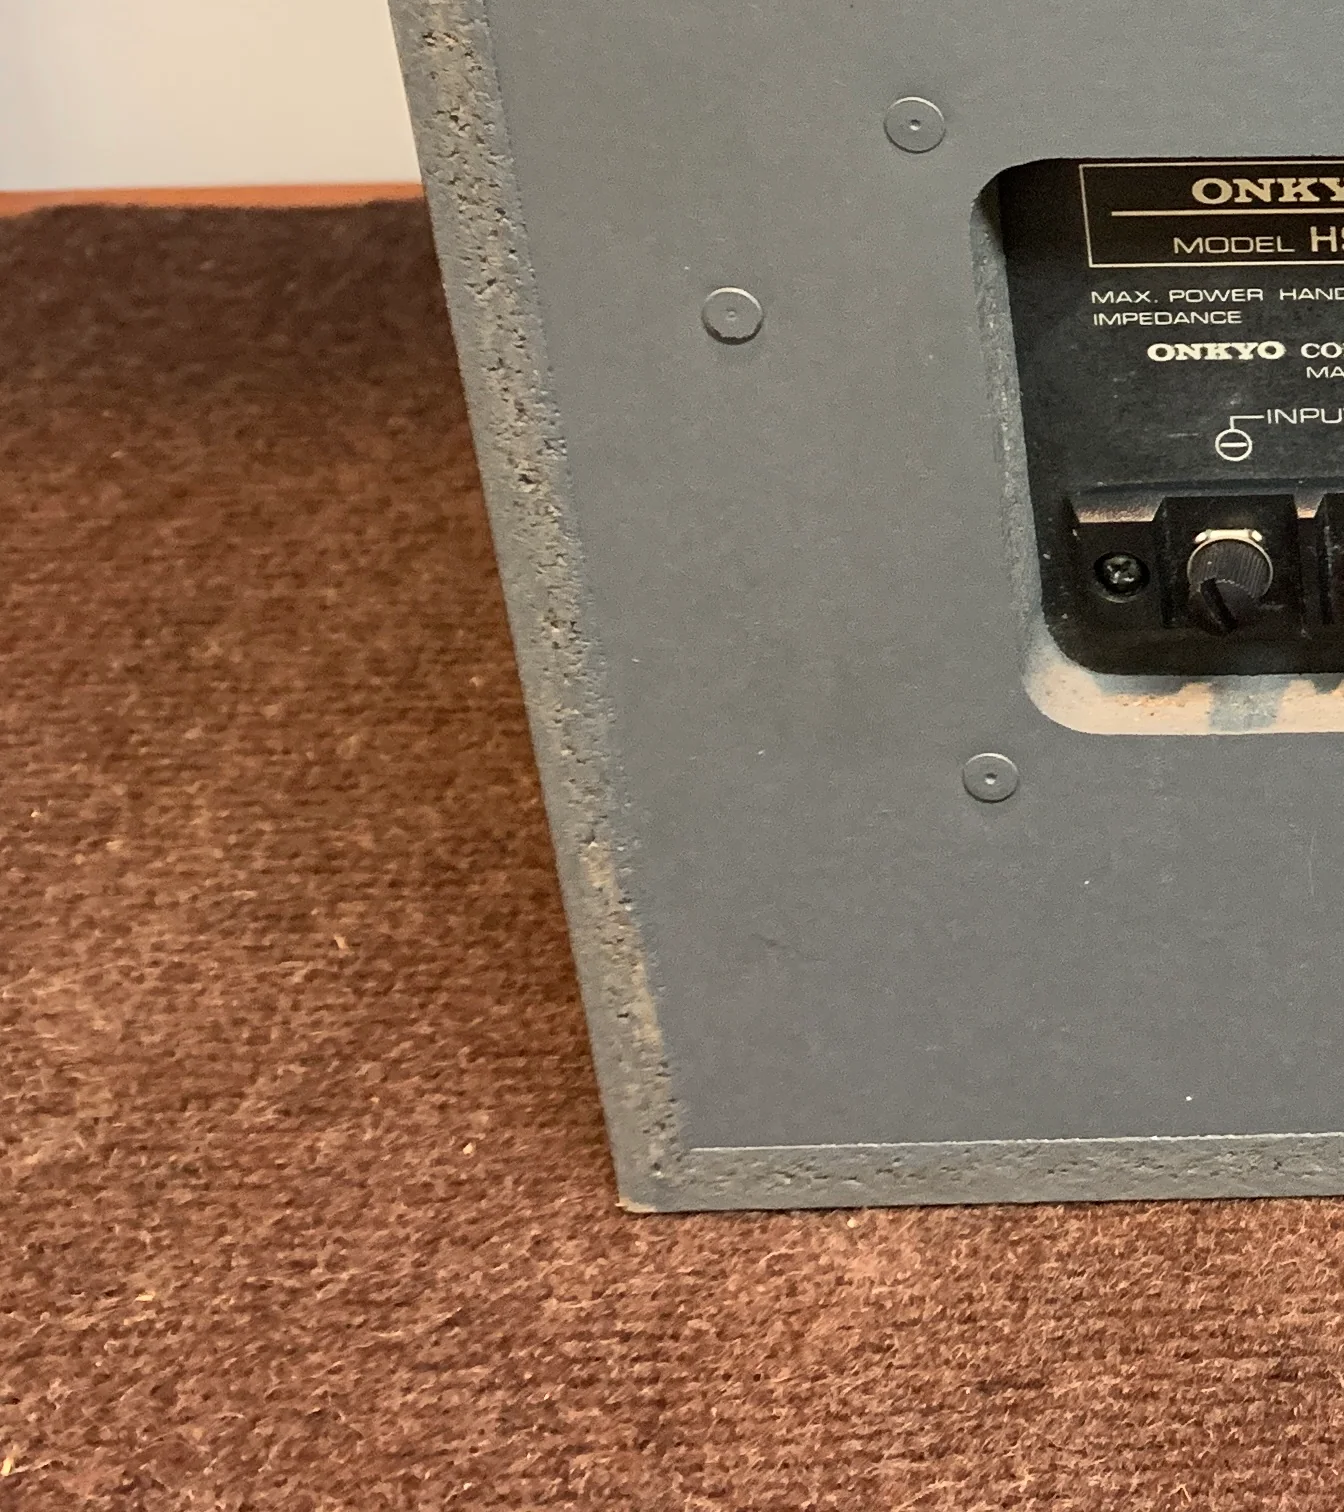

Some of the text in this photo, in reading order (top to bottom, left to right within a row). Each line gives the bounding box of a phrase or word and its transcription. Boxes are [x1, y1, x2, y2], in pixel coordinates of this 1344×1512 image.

[1174, 236, 1295, 254] MODEL
[1091, 289, 1159, 304] MAX.
[1169, 288, 1263, 303] POWER
[1093, 310, 1242, 326] IMPEDANCE
[1147, 341, 1285, 362] ONKYO
